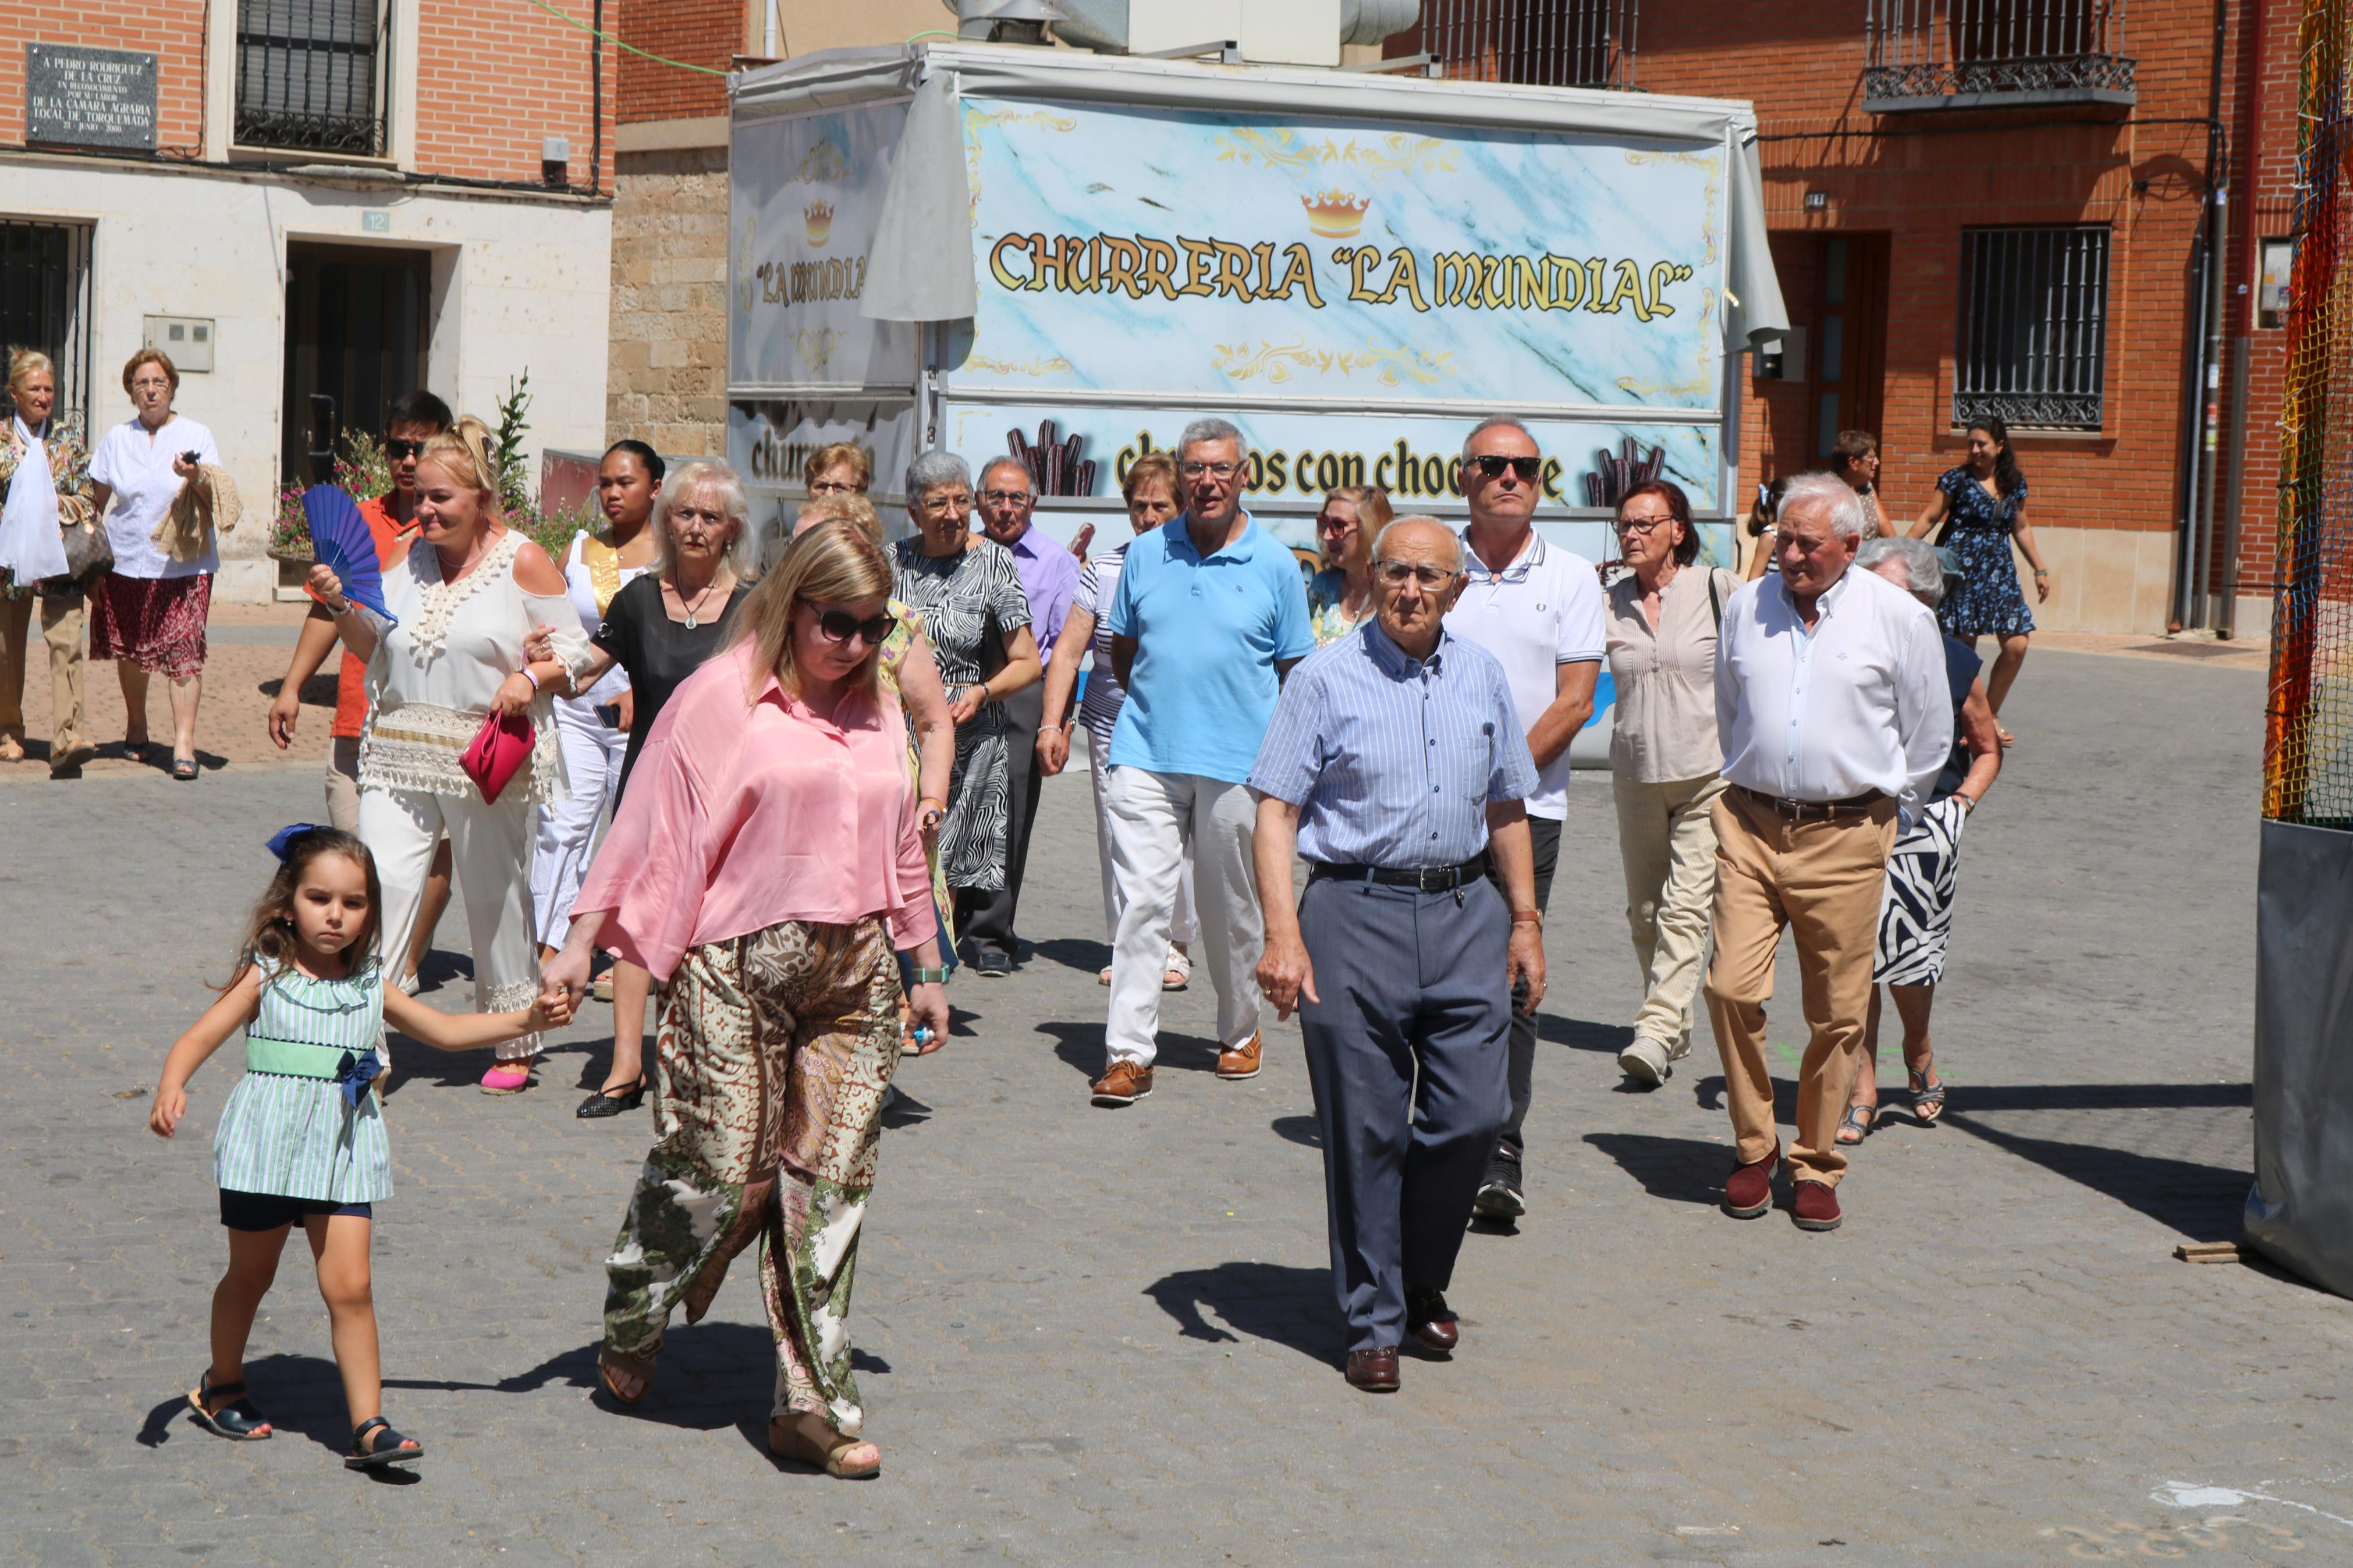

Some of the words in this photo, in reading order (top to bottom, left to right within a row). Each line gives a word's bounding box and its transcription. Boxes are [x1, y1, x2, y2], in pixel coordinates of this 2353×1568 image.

[44, 57, 50, 68] A
[54, 58, 86, 70] PEDRO
[90, 61, 142, 76] RODRIGUEZ
[65, 70, 76, 81] DE
[81, 71, 93, 83] LA
[97, 73, 120, 84] CRUZ
[58, 80, 66, 89] EN
[70, 81, 127, 94] RECONOCIMIENTO
[68, 90, 81, 98] POR
[95, 93, 118, 101] LABOR
[33, 95, 45, 107] DE
[50, 97, 62, 109] LA
[66, 98, 105, 112] CAMARA
[110, 102, 151, 116] AGRARIA
[34, 108, 65, 120] LOCAL
[69, 110, 80, 121] DE
[86, 111, 150, 127] TORQUEMADA
[79, 122, 98, 131] JUNIO
[370, 214, 384, 230] 12
[989, 232, 1326, 308] CHURRERIA
[790, 255, 867, 305] MUNDIA
[1294, 449, 1367, 495] con
[1372, 437, 1564, 502] choce
